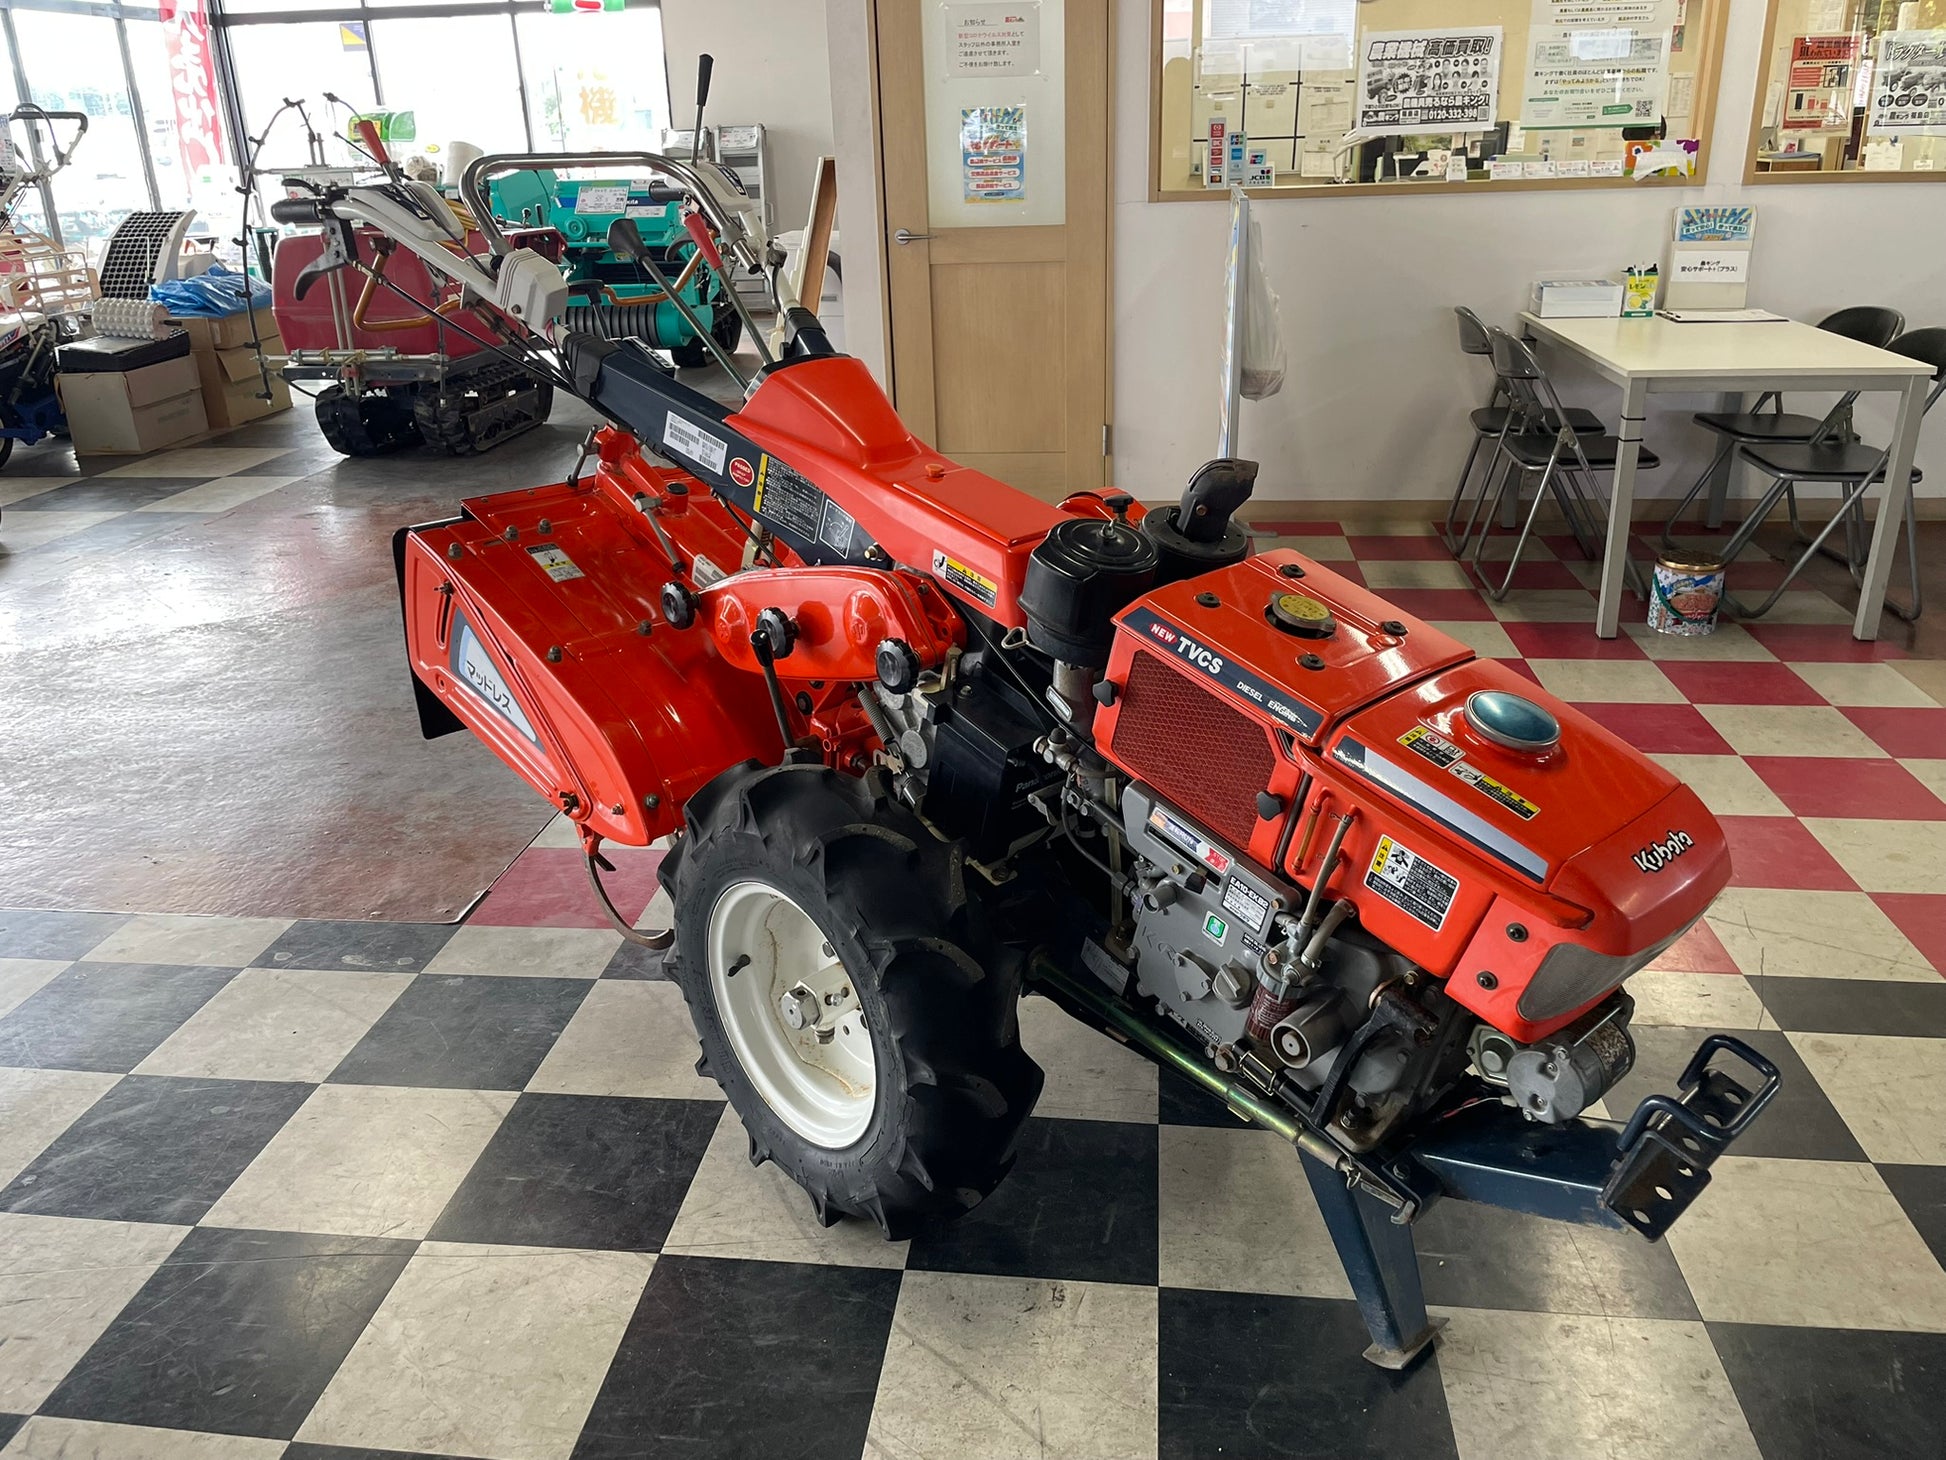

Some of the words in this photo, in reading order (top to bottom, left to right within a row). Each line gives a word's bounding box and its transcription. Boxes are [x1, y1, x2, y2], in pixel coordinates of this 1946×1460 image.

[964, 18, 986, 26] お知らせ
[1151, 623, 1175, 642] NEW
[1177, 636, 1224, 675] TVCS
[1236, 680, 1263, 702] DIESEL
[1633, 829, 1695, 873] Kubota
